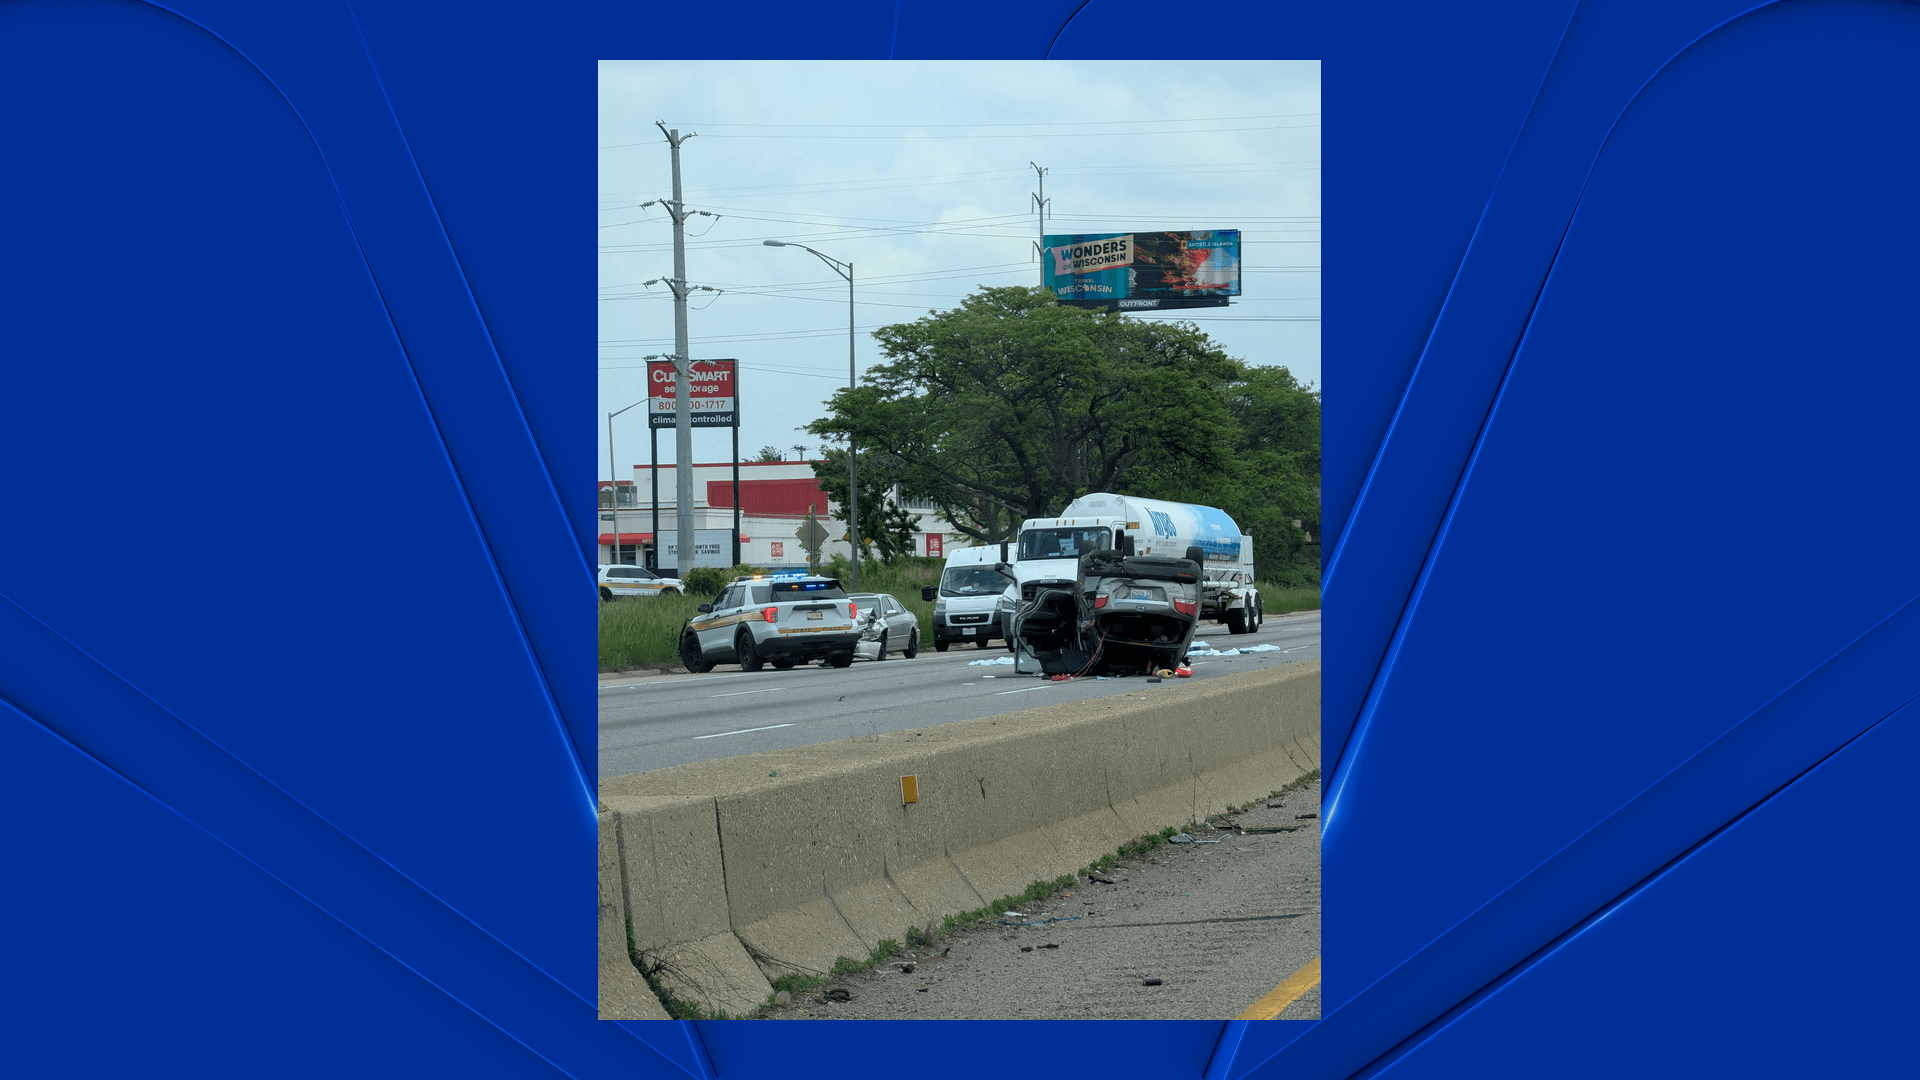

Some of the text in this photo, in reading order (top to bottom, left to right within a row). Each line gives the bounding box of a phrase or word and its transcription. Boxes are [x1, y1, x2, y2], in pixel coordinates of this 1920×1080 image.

[1061, 240, 1127, 260] WONDERS
[1062, 253, 1126, 271] OF WISCONSIN
[689, 384, 719, 394] torage
